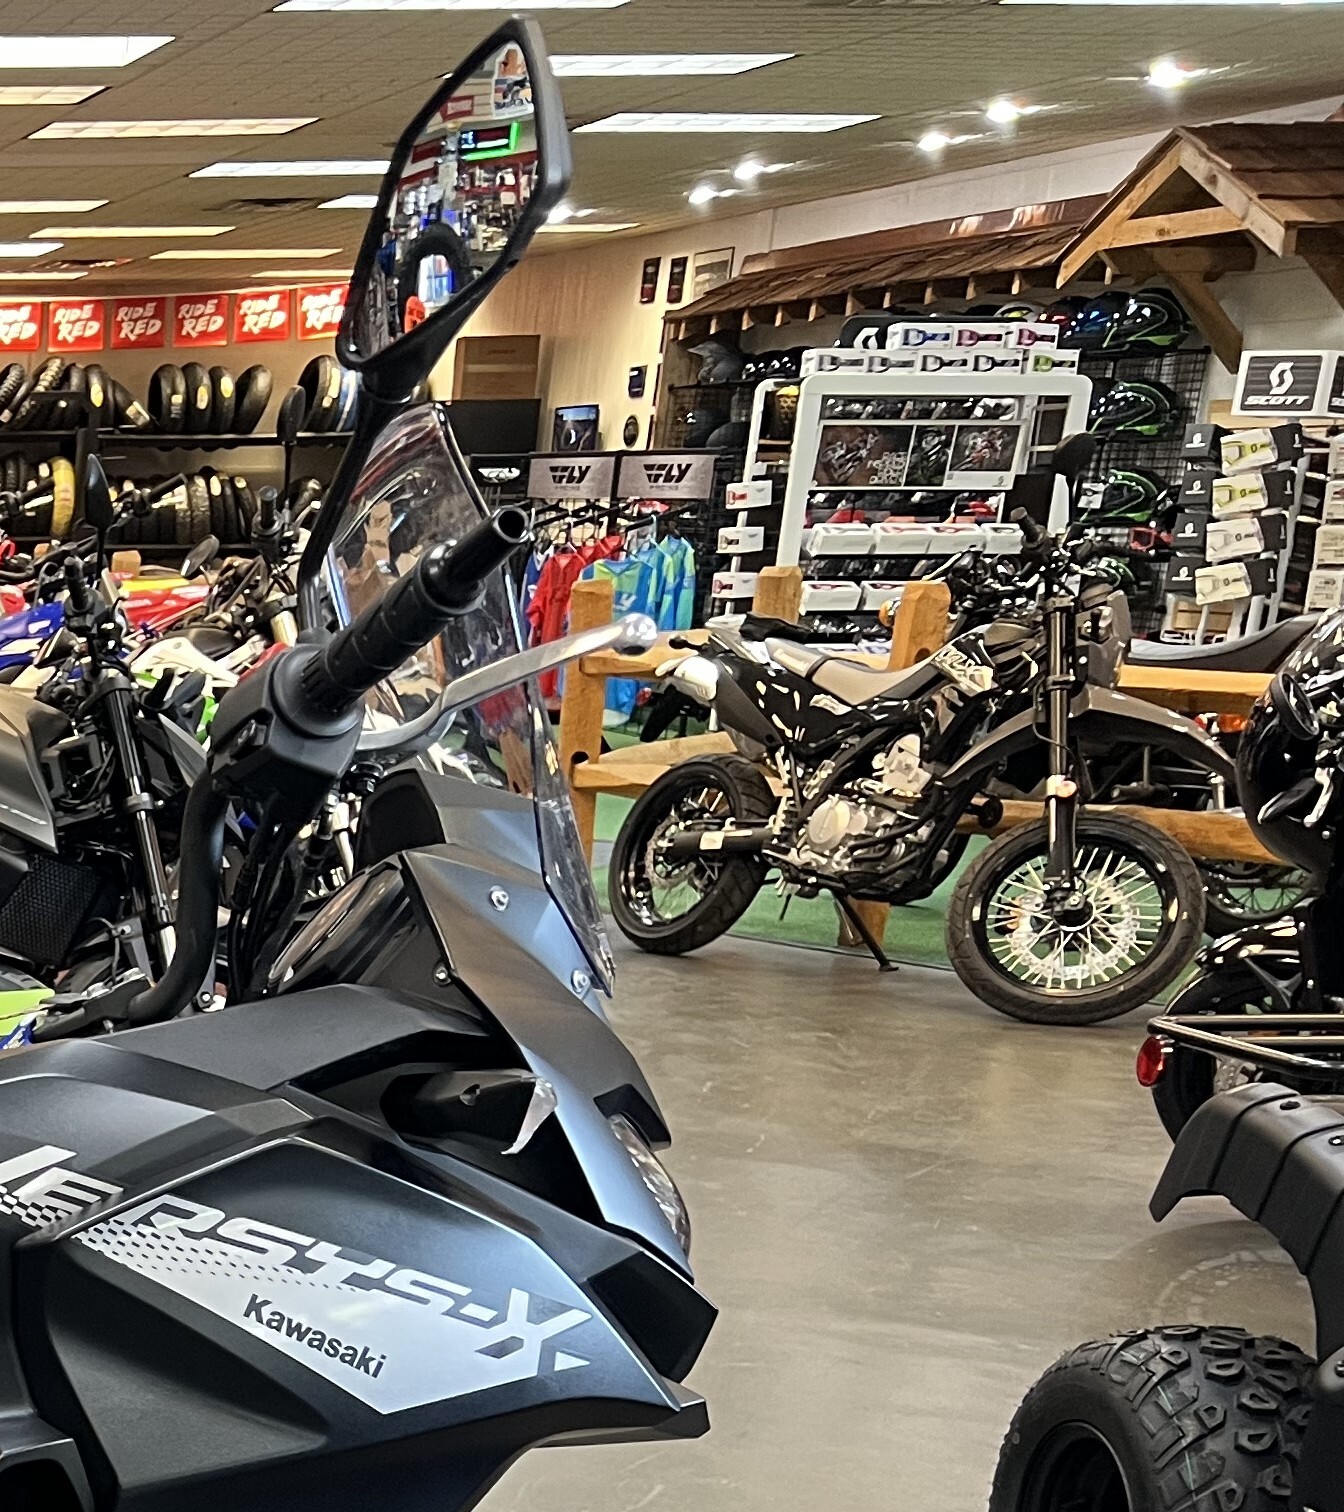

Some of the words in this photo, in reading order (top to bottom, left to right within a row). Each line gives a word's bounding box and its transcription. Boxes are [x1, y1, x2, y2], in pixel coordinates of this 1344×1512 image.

[177, 299, 219, 318] RIDE
[239, 294, 280, 315] RIDE
[301, 288, 343, 311] RIDE
[53, 303, 95, 323] RIDE
[115, 302, 157, 321] RIDE
[242, 310, 286, 334] RED
[57, 320, 100, 343] RED
[119, 319, 162, 341] RED
[181, 315, 224, 338] RED
[1244, 395, 1310, 405] SCOTT
[549, 465, 591, 484] FLY
[643, 463, 694, 484] FLY
[243, 1293, 387, 1379] Kawasaki
